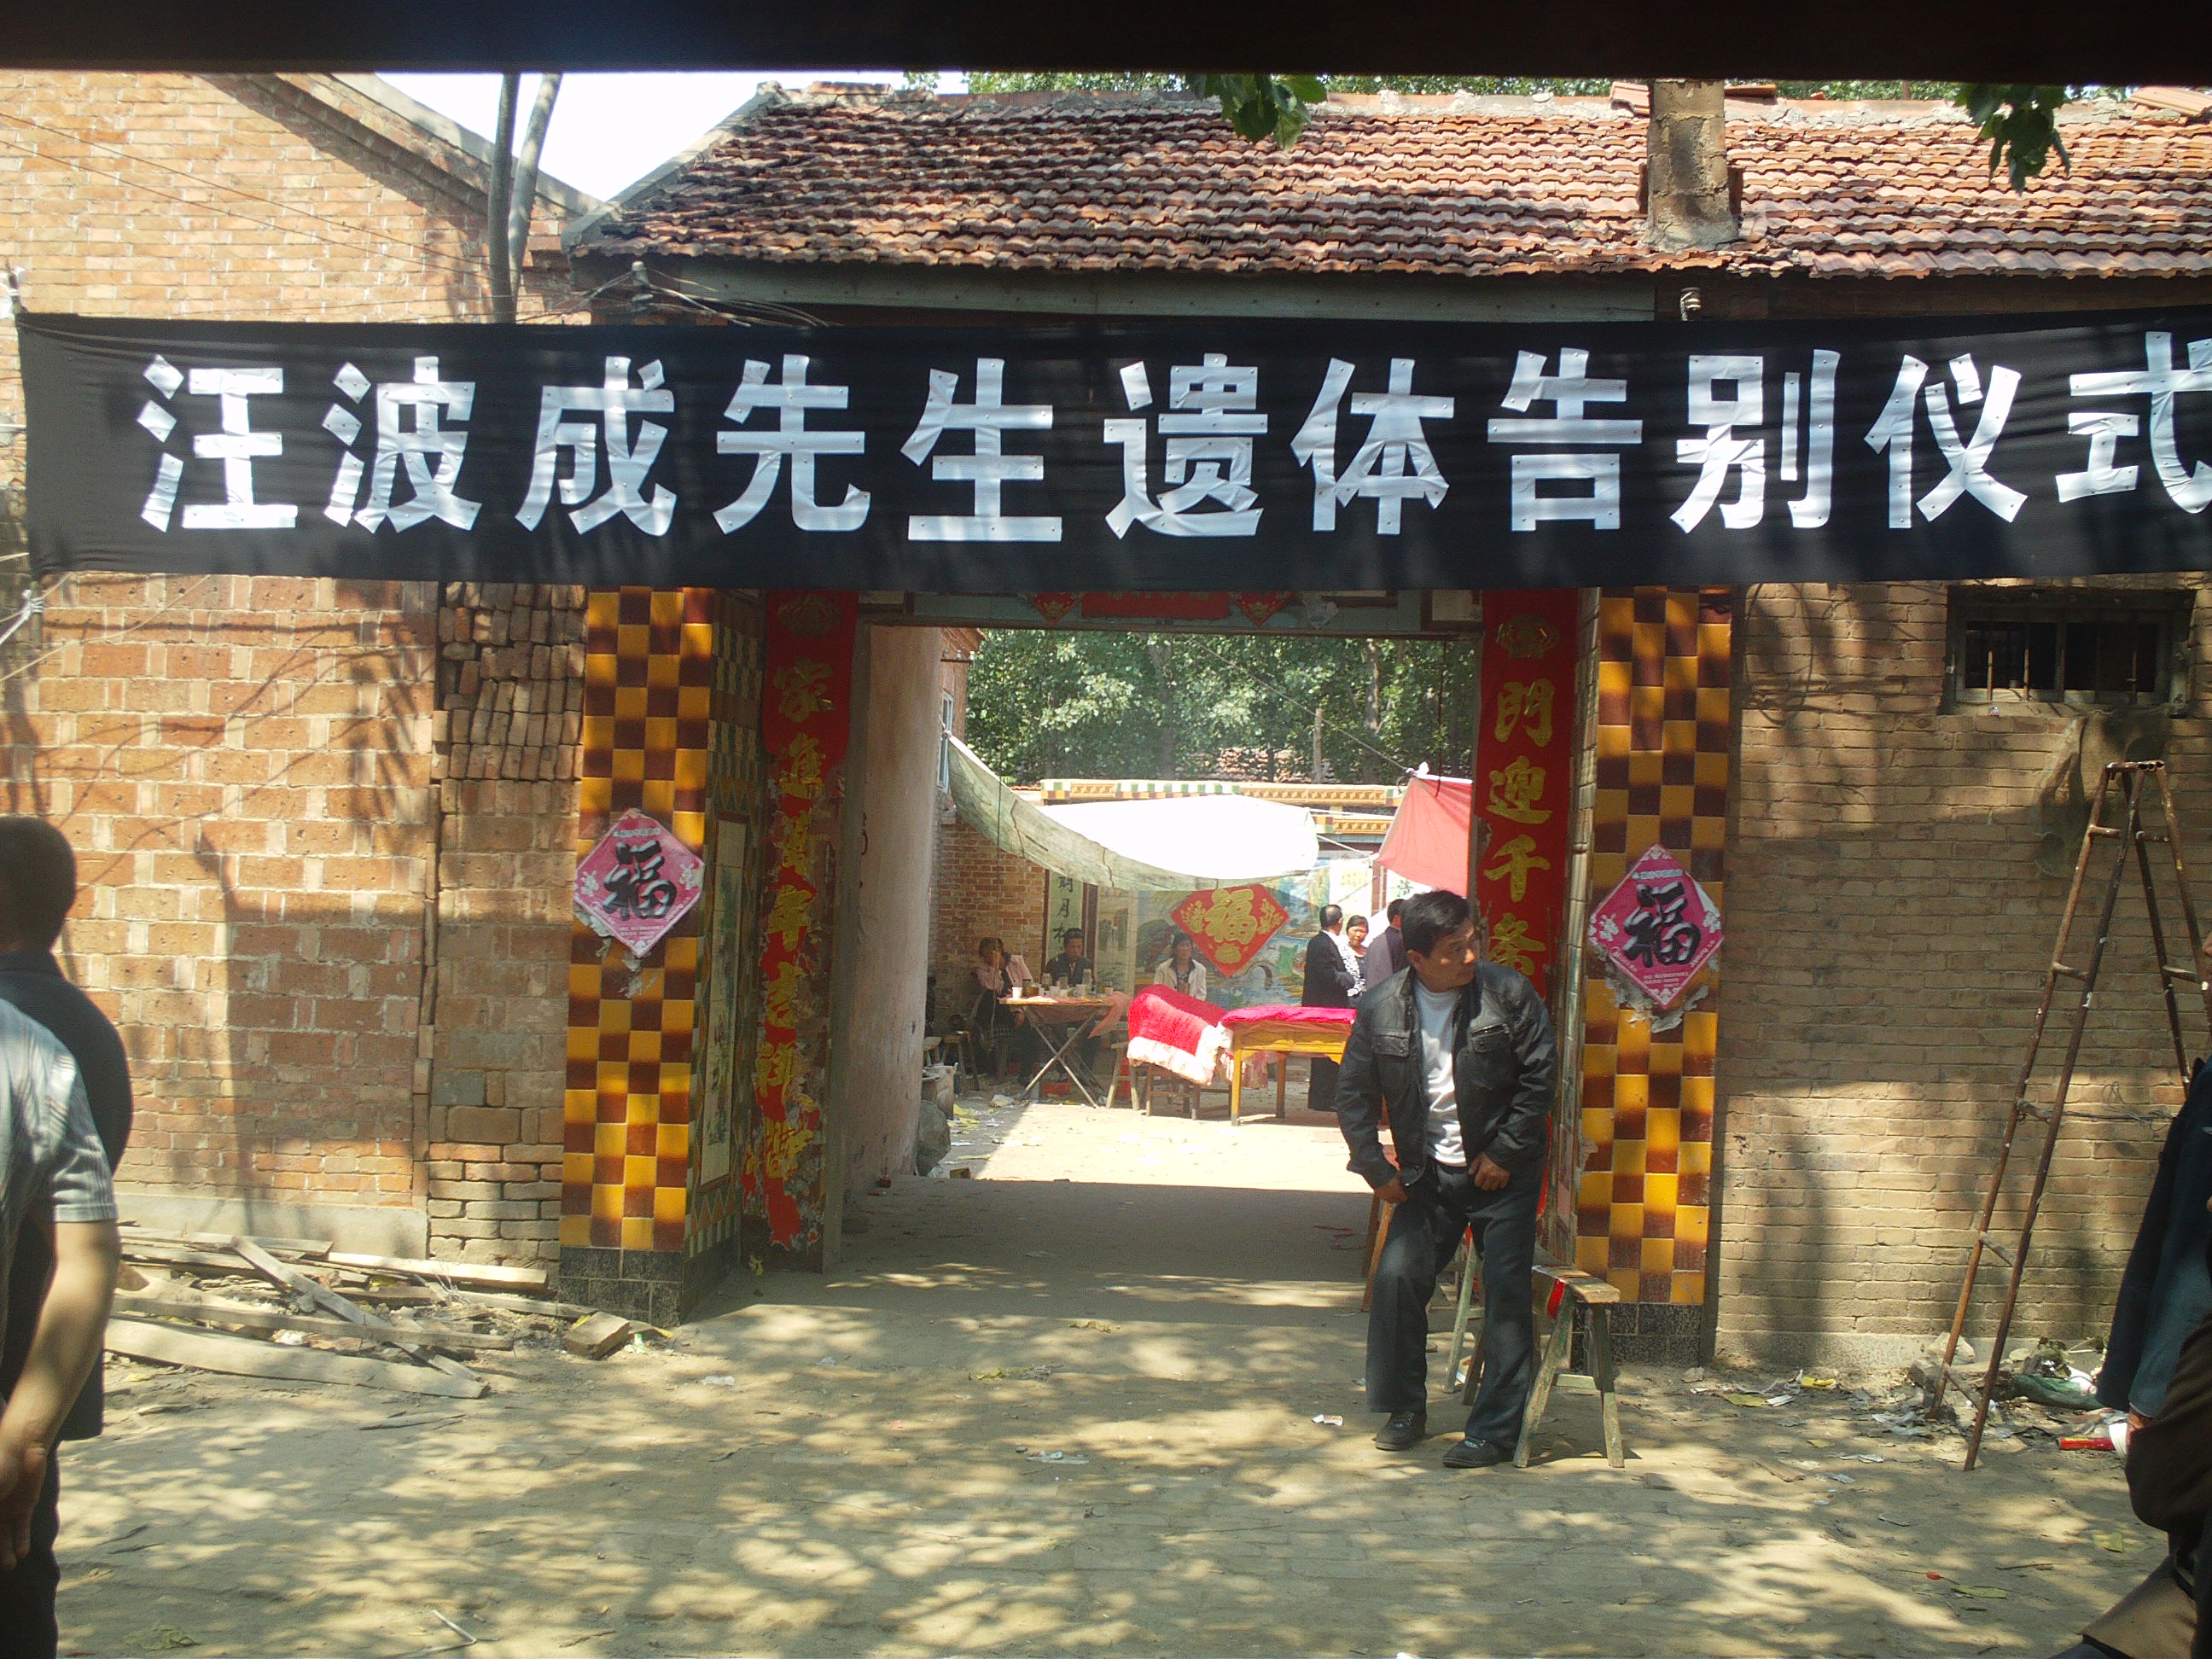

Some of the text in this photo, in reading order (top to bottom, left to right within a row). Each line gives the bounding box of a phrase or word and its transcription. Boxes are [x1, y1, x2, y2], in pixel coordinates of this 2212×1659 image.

[137, 330, 2212, 542] 汪波成先生遗体告别仪式
[602, 839, 678, 922] 福
[1203, 888, 1258, 945] 福
[1623, 881, 1702, 969] 福
